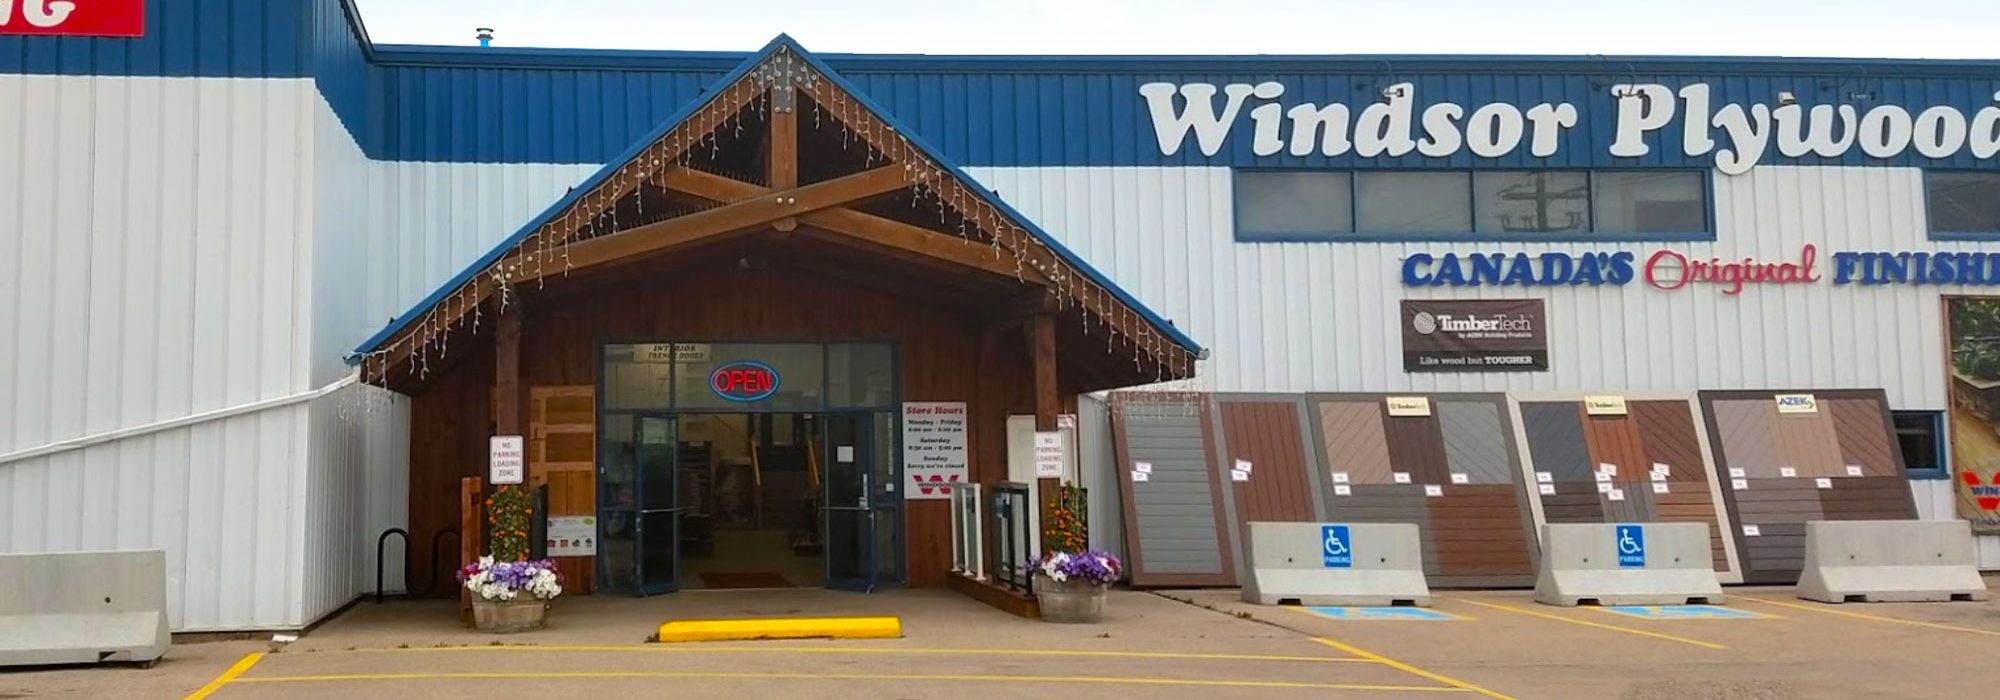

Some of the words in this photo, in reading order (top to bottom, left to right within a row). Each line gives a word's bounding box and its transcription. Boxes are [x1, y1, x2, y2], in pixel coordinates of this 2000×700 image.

[1138, 81, 1578, 158] Windsor
[1402, 251, 1635, 287] CANADA'S
[1644, 243, 1822, 295] Original
[1437, 313, 1532, 331] TimberTech
[653, 344, 697, 352] INTRIOR
[1420, 356, 1440, 365] Like
[1441, 356, 1466, 365] wood
[1468, 356, 1482, 365] but
[1484, 355, 1534, 365] TOUGHER
[714, 370, 773, 392] OPEN
[906, 406, 933, 415] Store
[935, 406, 964, 414] Hours
